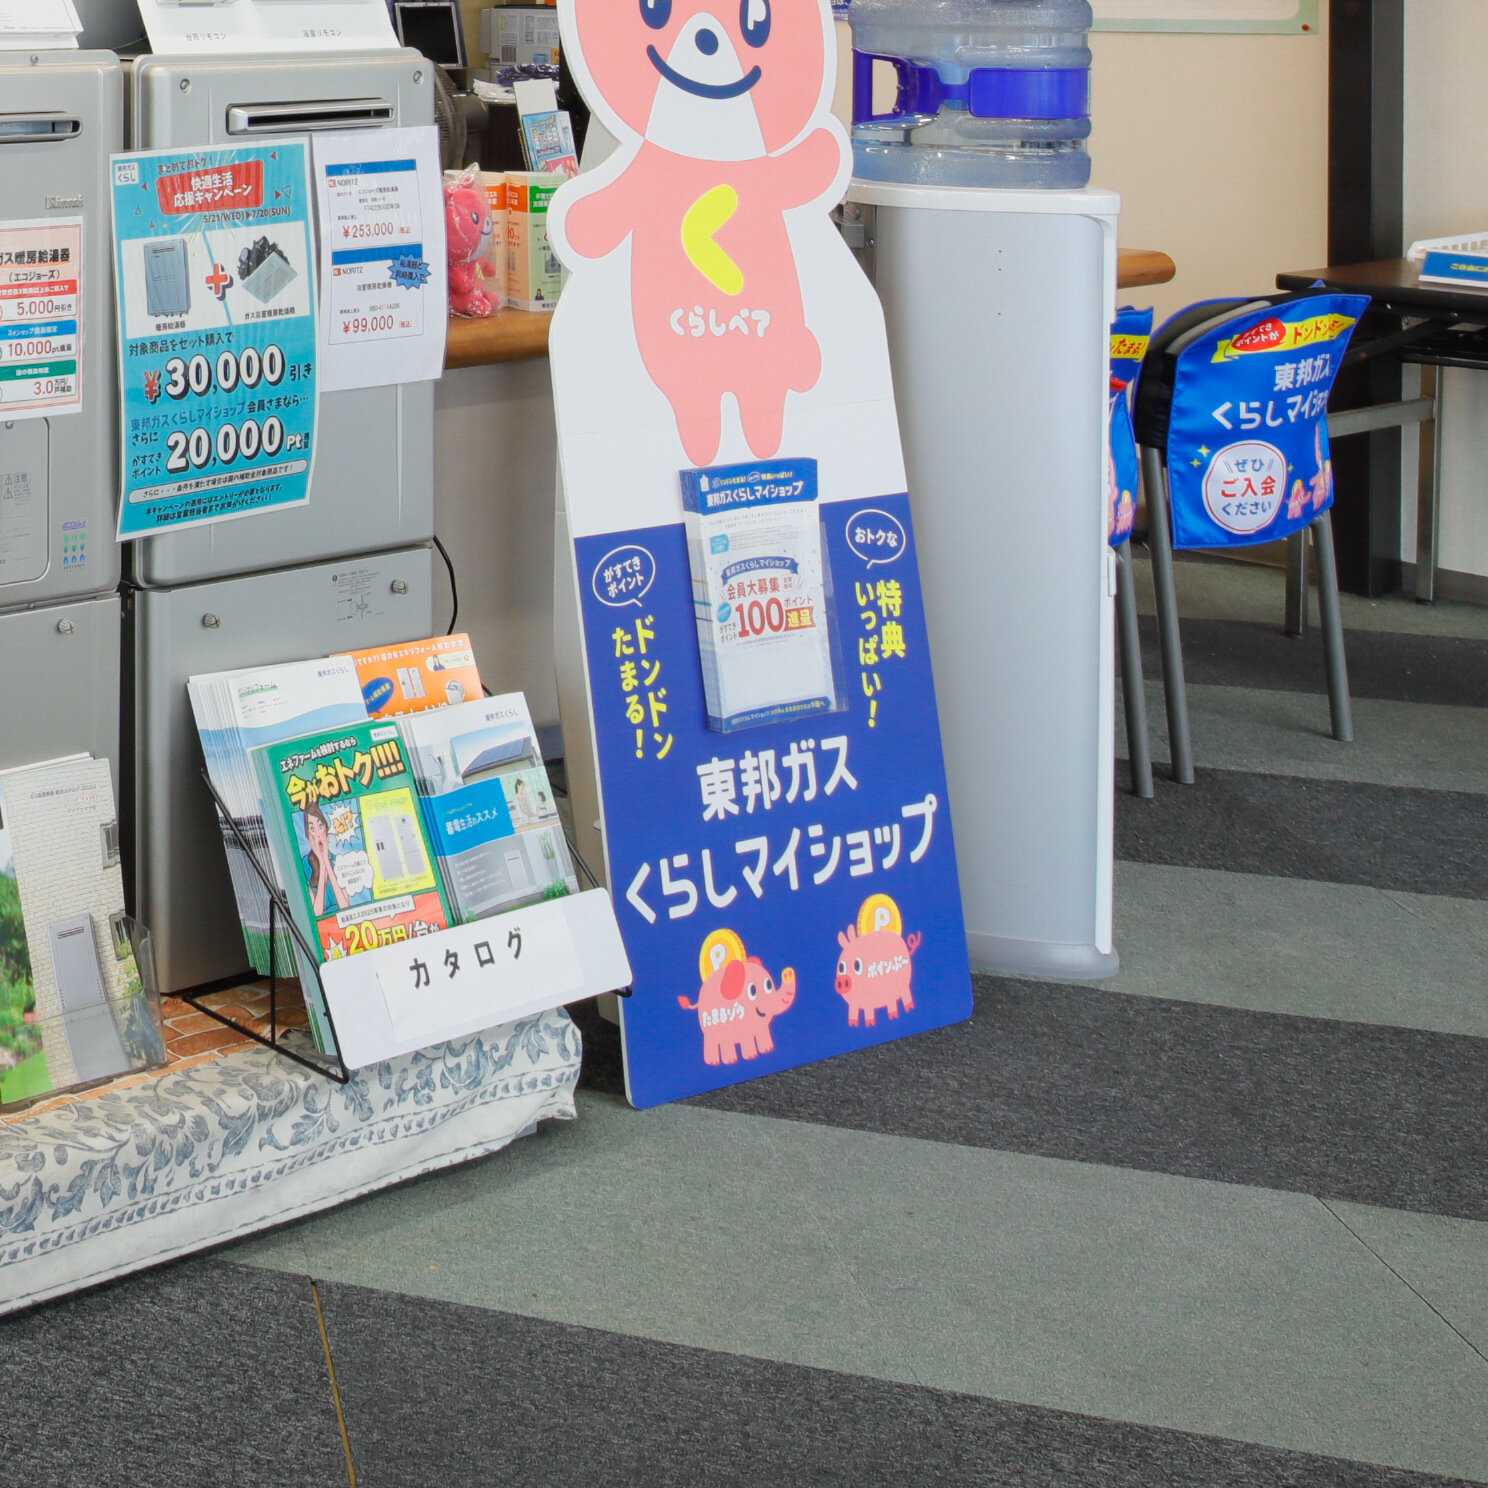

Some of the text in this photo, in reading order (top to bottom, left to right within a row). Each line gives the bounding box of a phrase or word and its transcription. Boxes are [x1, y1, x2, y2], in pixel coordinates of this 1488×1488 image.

[118, 171, 137, 183] くらし
[190, 171, 233, 191] 快適生活
[337, 178, 358, 187] NORITZ
[173, 184, 252, 208] 応援キャンペーン
[203, 206, 291, 224] 5/21(WED) 7/20(SUN)
[342, 222, 394, 239] ¥253,000
[342, 266, 363, 276] NORITZ
[670, 306, 772, 339] くらしベア
[33, 379, 54, 396] 3.0
[131, 431, 158, 445] さらに
[165, 415, 284, 475] 20,000
[131, 452, 162, 466] がすてき
[1233, 459, 1265, 473] ぜひ
[132, 466, 161, 479] ポイント
[706, 481, 804, 507] 東邦ガスくらしマイショップ
[1220, 475, 1276, 498] ご入会
[1222, 500, 1272, 517] ください
[854, 527, 899, 548] おトクな
[603, 557, 642, 583] がすてき
[607, 573, 644, 598] ポイント
[735, 594, 813, 640] 100 ポイント
[854, 579, 906, 728] 特典 いっぱい!
[612, 615, 674, 760] ドンドン たまる!
[696, 734, 858, 822] 東邦ガス
[446, 808, 498, 835] 蓄電生活のススメ
[625, 793, 938, 924] くらしマイショップ
[408, 929, 525, 990] カタログ
